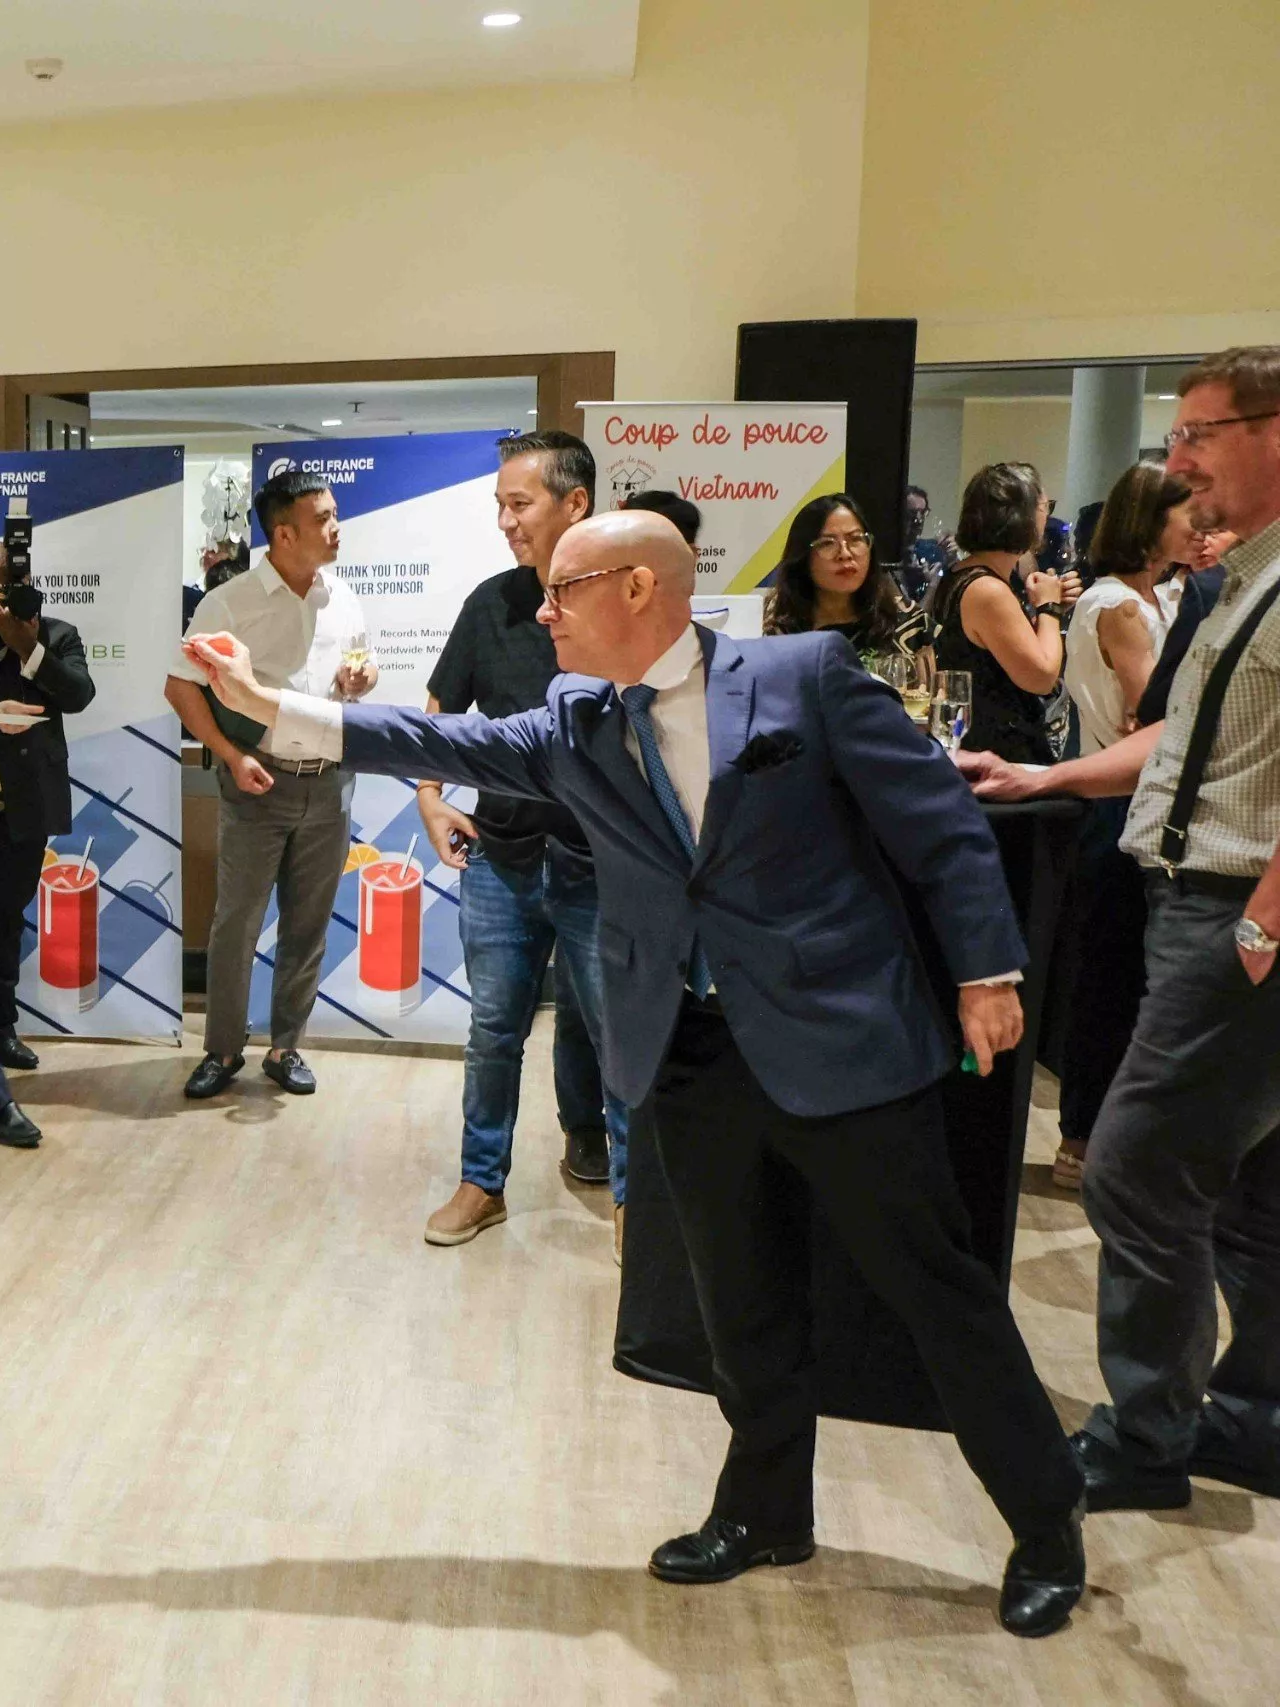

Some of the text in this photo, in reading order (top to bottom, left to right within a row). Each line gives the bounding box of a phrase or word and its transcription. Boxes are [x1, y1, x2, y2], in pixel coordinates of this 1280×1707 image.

[605, 413, 828, 451] Coup de pouce
[302, 458, 374, 473] CCI FRANCE
[1, 471, 46, 484] FRANCE
[678, 474, 779, 500] Vietnam
[335, 563, 430, 578] THANK YOU TO OUR
[45, 575, 63, 587] YOU
[67, 574, 78, 587] TO
[81, 574, 100, 587] OUR
[377, 581, 423, 594] SPONSOR
[50, 591, 94, 604] SPONSOR
[380, 629, 418, 638] Records
